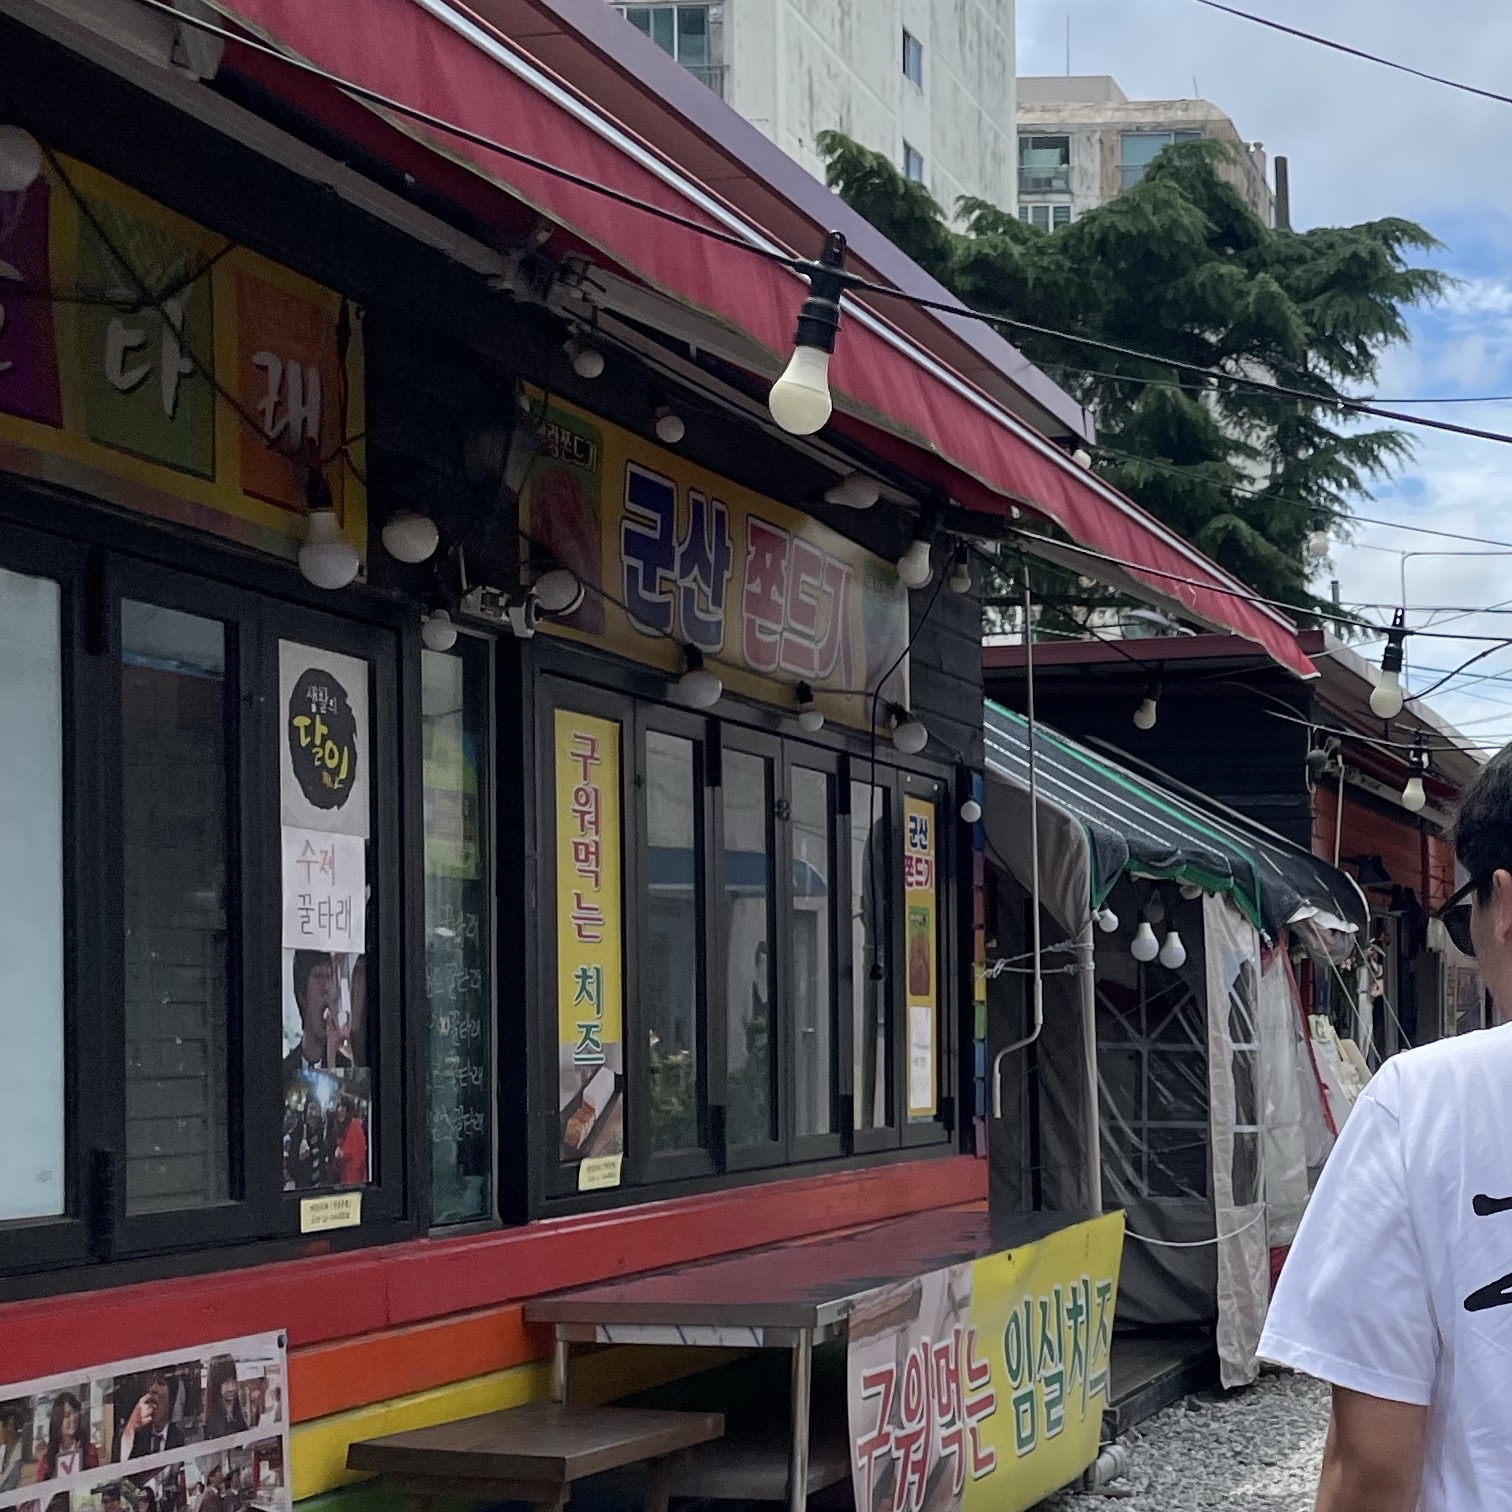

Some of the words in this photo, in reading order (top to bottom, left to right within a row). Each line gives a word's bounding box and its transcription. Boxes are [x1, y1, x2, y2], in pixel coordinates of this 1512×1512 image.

[620, 458, 733, 653] 군산
[742, 513, 856, 696] 쫀드기
[292, 714, 349, 790] 달인
[296, 839, 335, 886] 수제
[569, 732, 606, 943] 구워먹는
[908, 814, 929, 850] 군산
[904, 854, 933, 890] 쫀드기
[297, 893, 352, 939] 꿀타래
[571, 965, 606, 1068] 치즈
[1003, 1273, 1113, 1458] 임실치즈
